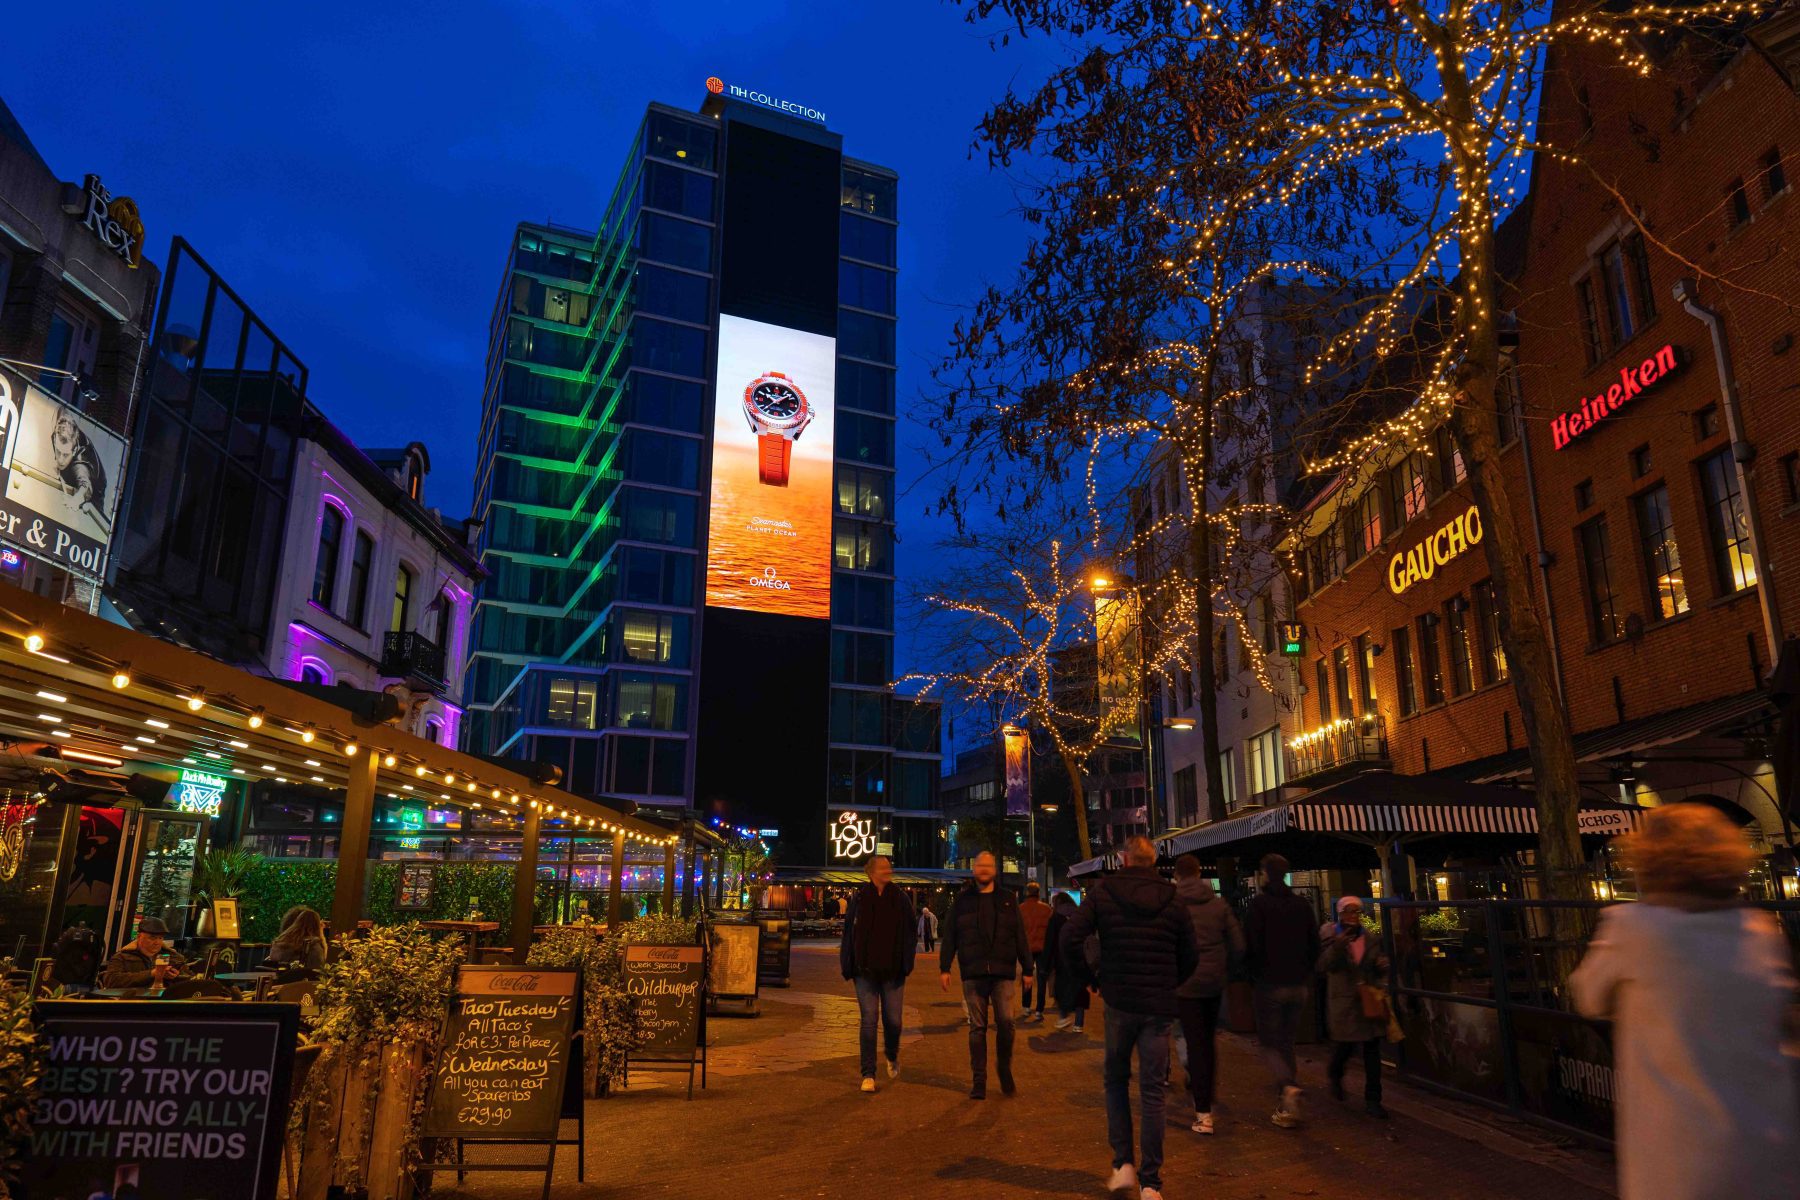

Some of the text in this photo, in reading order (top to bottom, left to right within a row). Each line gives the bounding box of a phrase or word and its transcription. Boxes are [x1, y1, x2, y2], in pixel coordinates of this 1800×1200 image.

[750, 91, 826, 122] COLLECTION
[83, 189, 136, 265] Rex
[1550, 344, 1677, 451] Heineken
[747, 525, 771, 533] PLANET
[26, 519, 48, 548] &
[53, 528, 101, 572] Pool
[749, 576, 791, 591] OMEGA
[830, 820, 872, 842] LOU
[1578, 813, 1621, 828] UCHOS
[834, 836, 876, 858] LOU
[460, 998, 557, 1019] Taco Tuesday
[469, 1018, 533, 1034] All Taco's
[49, 1036, 224, 1063] WHO IS THE
[523, 1035, 551, 1048] Piece
[450, 1056, 548, 1077] Wednesday
[40, 1067, 270, 1095] BEST? TRY OUR
[443, 1076, 460, 1090] All
[462, 1078, 488, 1097] you
[492, 1079, 518, 1089] can
[469, 1089, 531, 1104] Spareribs
[33, 1098, 178, 1126] BOWLING
[31, 1131, 247, 1160] WITH FRIENDS
